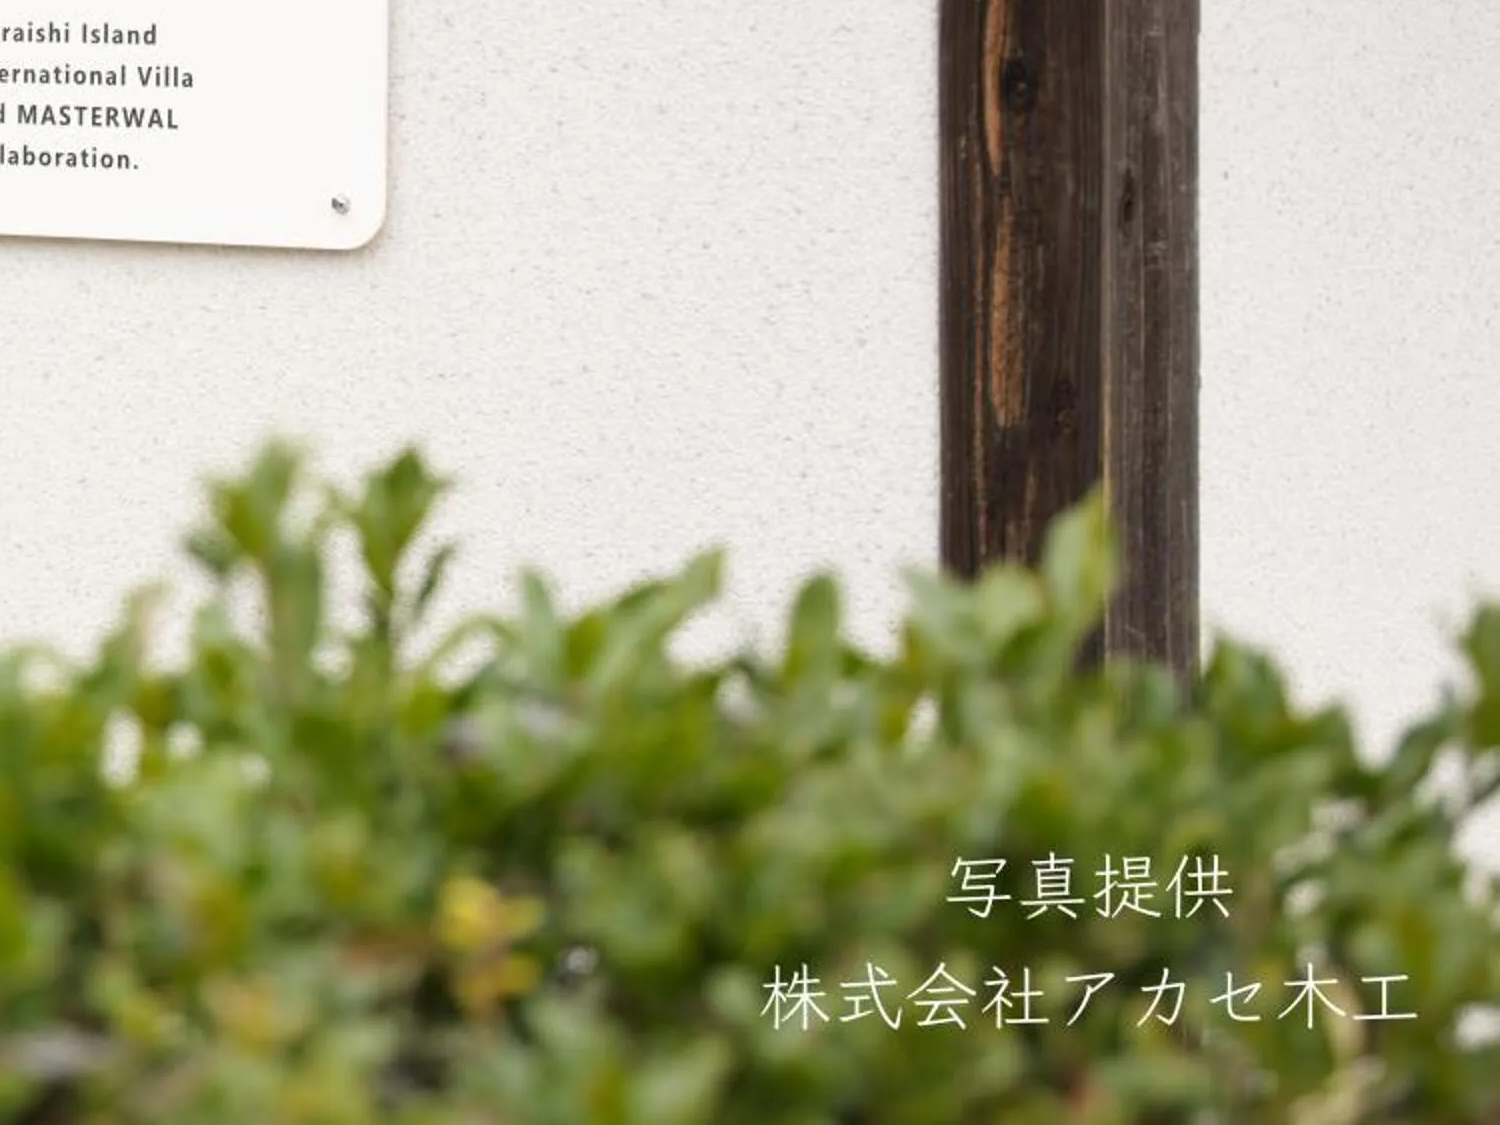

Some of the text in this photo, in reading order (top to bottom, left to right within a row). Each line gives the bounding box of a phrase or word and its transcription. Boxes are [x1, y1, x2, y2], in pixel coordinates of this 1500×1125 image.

[82, 22, 158, 46] Island
[137, 65, 194, 89] Villa
[16, 104, 180, 130] MASTERWAL
